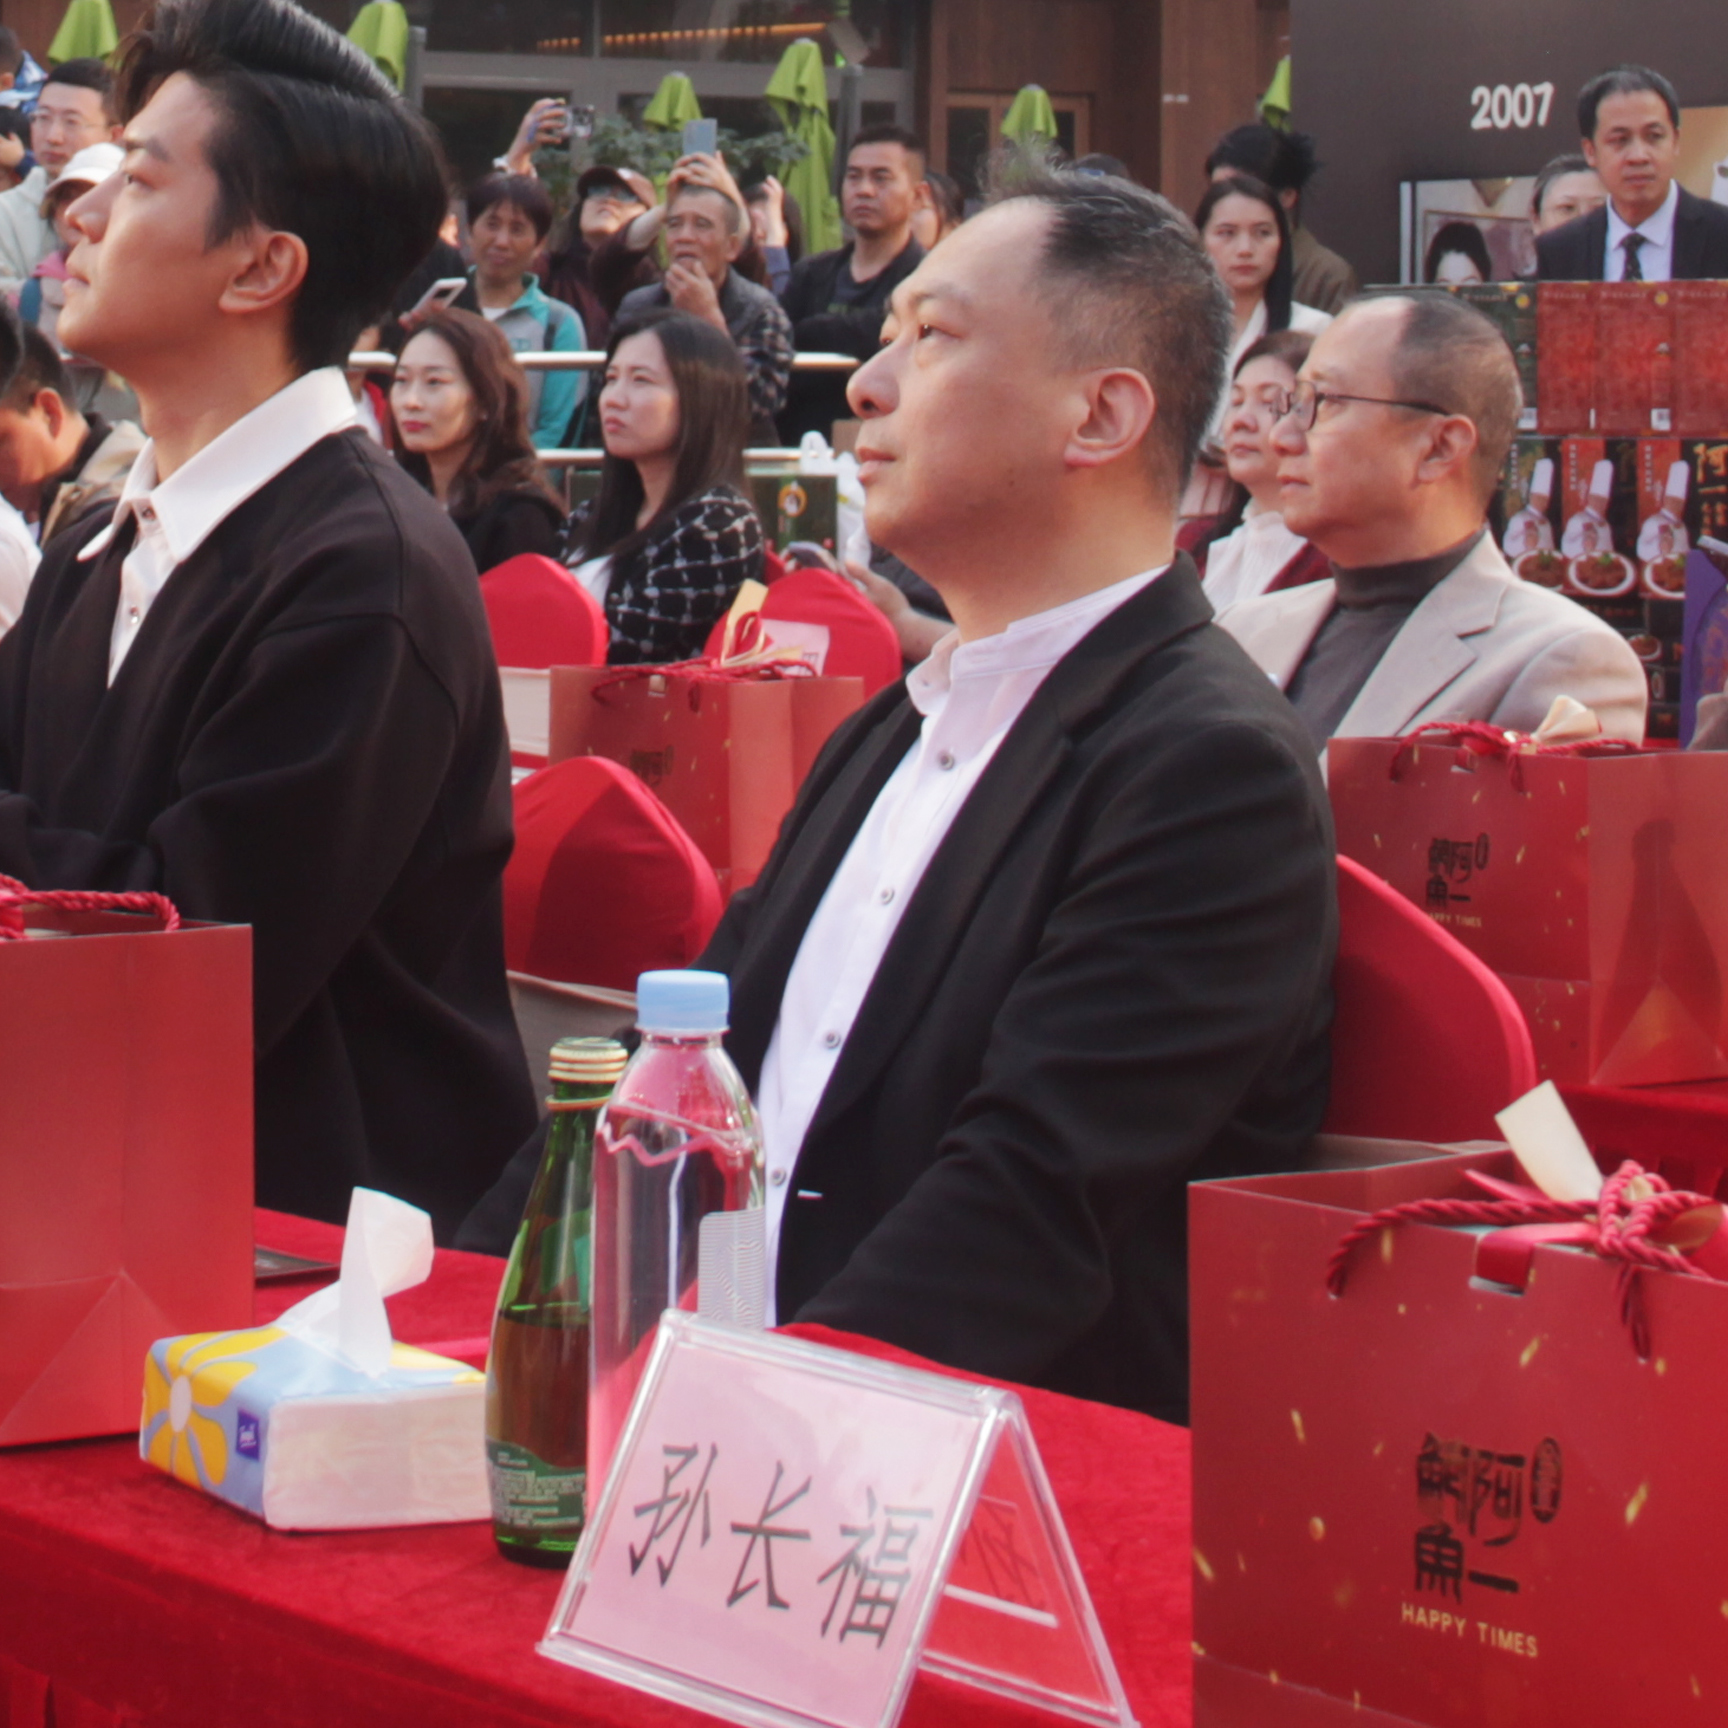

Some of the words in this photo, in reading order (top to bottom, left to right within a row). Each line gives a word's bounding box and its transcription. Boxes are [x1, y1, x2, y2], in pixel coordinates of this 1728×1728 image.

[1472, 82, 1554, 130] 2007
[629, 1441, 933, 1648] 孙长福
[1401, 1602, 1467, 1638] HAPPY
[1477, 1621, 1538, 1658] TIMES
